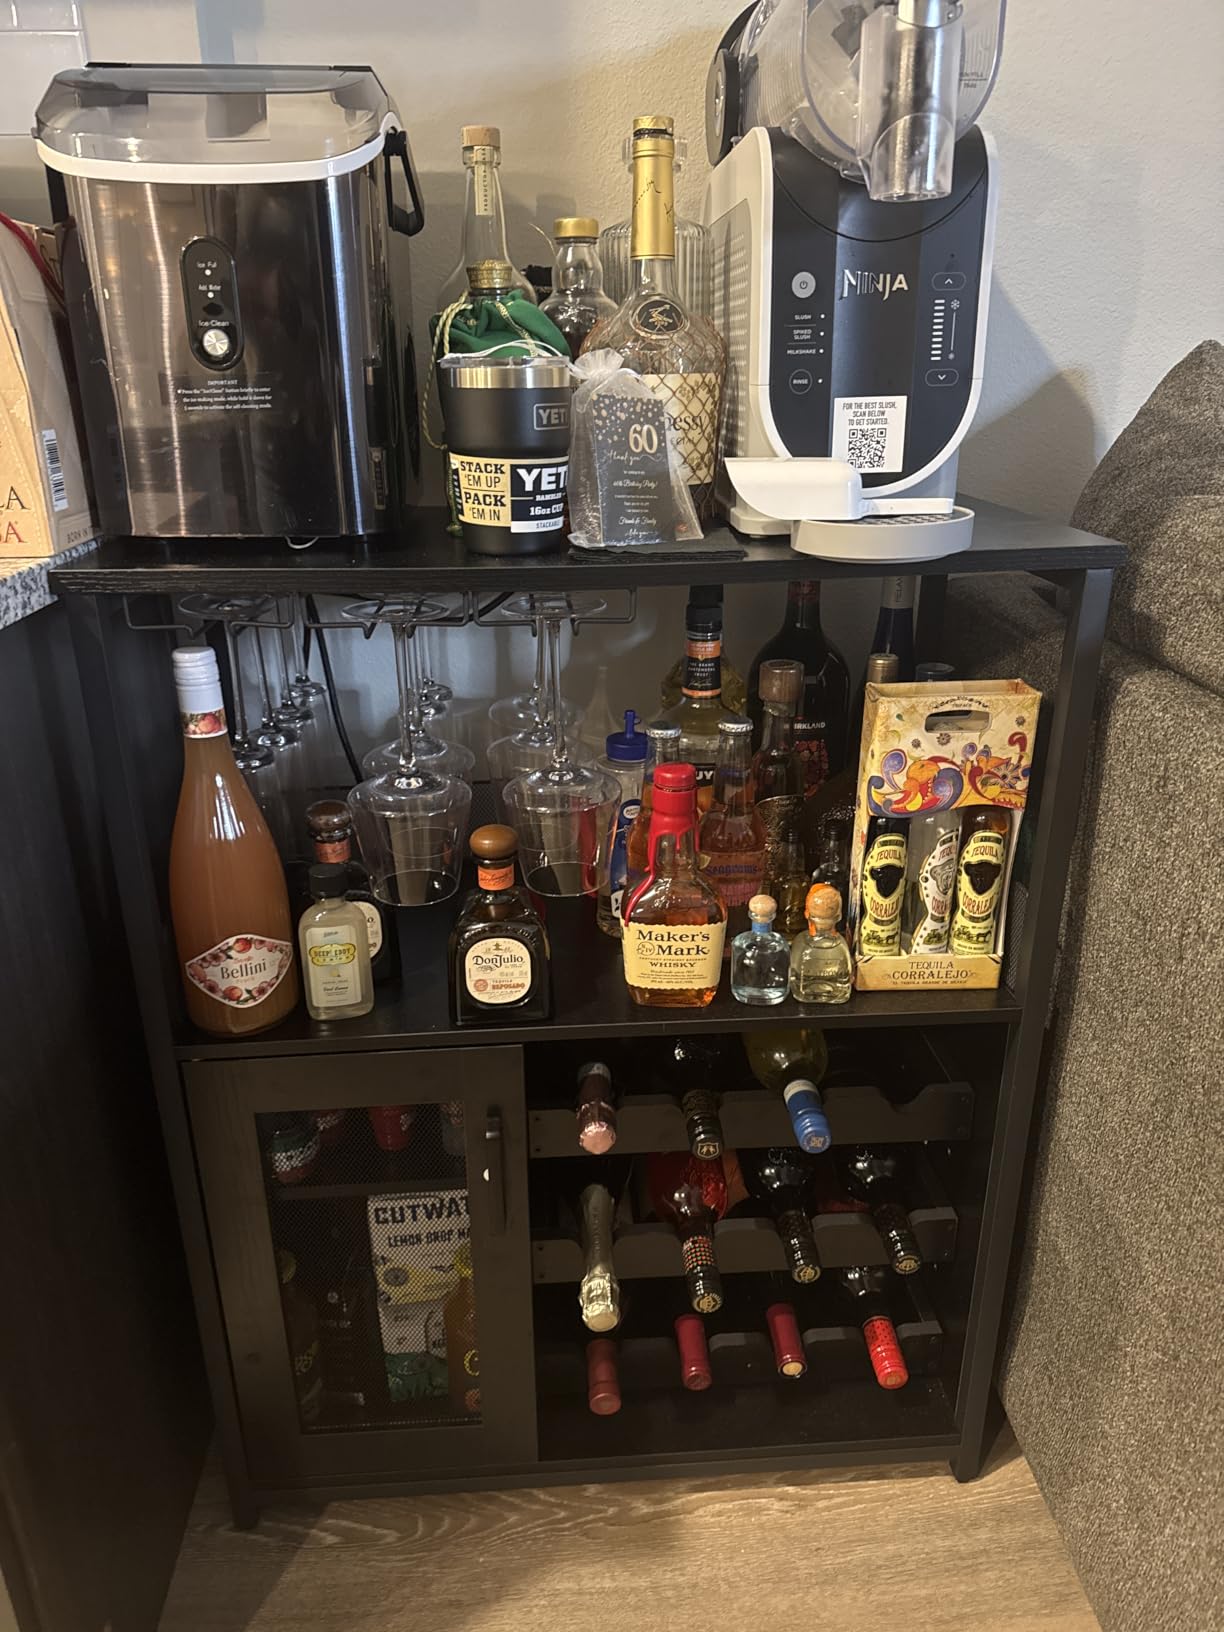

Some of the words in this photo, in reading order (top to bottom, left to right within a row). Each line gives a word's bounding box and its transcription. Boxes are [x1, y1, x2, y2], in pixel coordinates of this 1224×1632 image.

[842, 269, 909, 301] NINJA
[842, 402, 853, 410] FOR
[854, 402, 863, 410] THE
[864, 401, 877, 410] BEST
[848, 418, 855, 426] TO
[855, 418, 865, 426] GET
[629, 423, 658, 454] 60
[460, 460, 506, 475] STACK
[485, 475, 501, 489] UP
[463, 491, 506, 507] PACK
[489, 509, 501, 521] IN
[529, 506, 551, 516] 16oz
[794, 722, 826, 730] IRKLAND
[972, 844, 998, 858] TEQUILA
[637, 929, 710, 942] Maker's
[656, 944, 708, 956] Mark
[472, 955, 498, 966] Don
[495, 954, 524, 969] Julio
[908, 961, 954, 970] TEQUILA
[220, 958, 267, 980] Bellini
[892, 970, 969, 980] CORRALEJO
[388, 1233, 422, 1248] LEMON
[426, 1230, 454, 1244] DROP
